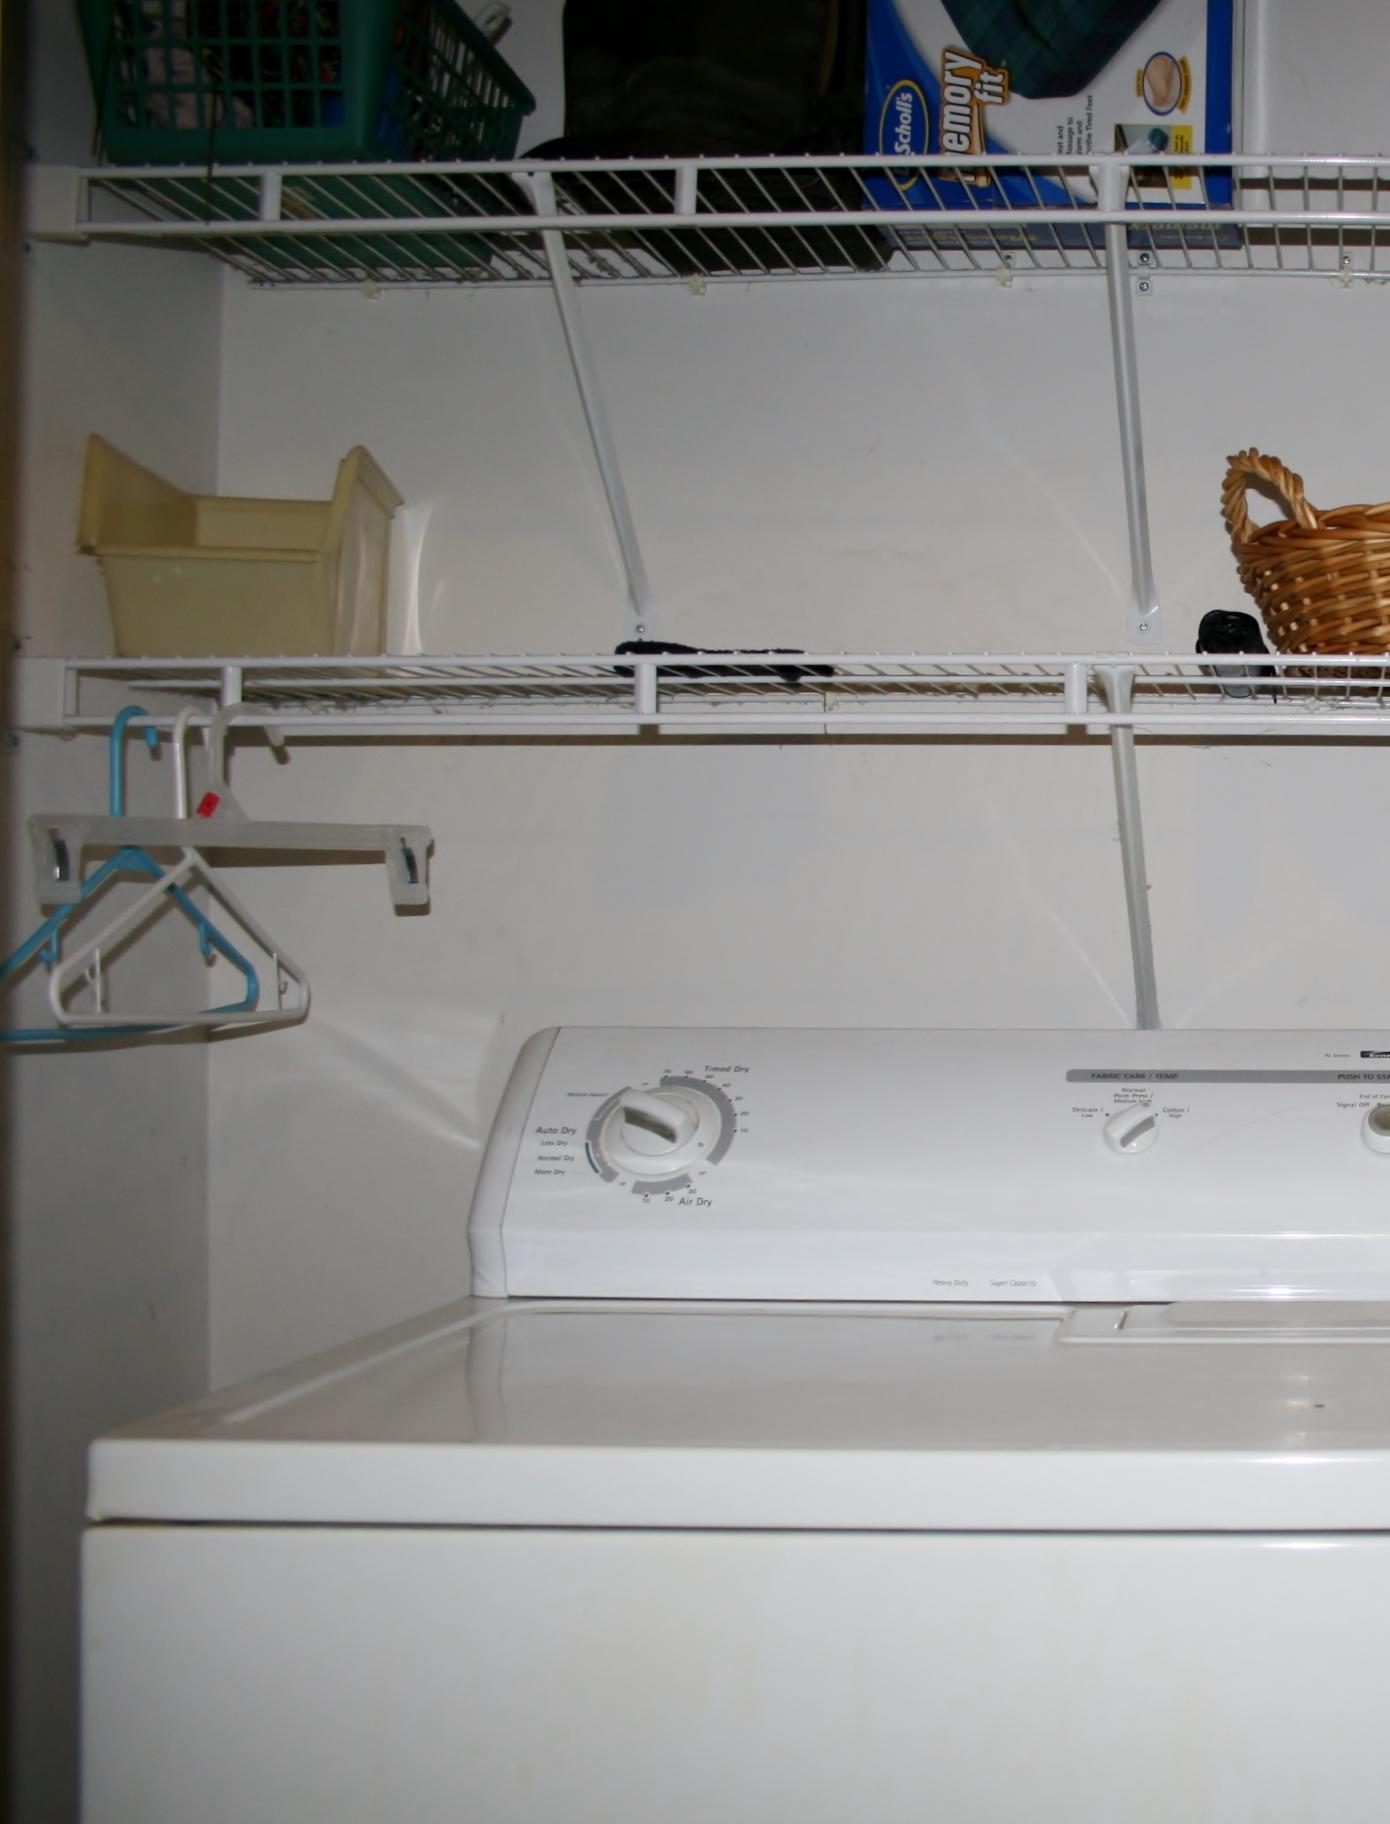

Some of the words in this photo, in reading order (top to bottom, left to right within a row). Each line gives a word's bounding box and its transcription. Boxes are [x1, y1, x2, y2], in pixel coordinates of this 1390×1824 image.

[974, 71, 1004, 103] fit
[704, 1065, 731, 1073] Timed
[734, 1065, 749, 1073] Dry
[1091, 1072, 1121, 1080] FABRIC
[1123, 1072, 1146, 1080] CARE
[1155, 1072, 1178, 1080] TEMP
[1336, 1101, 1357, 1109] Signal
[535, 1126, 558, 1135] Auto
[561, 1126, 577, 1136] Dry
[678, 1197, 693, 1206] Air
[696, 1197, 713, 1208] Dry
[953, 1279, 968, 1288] Duty
